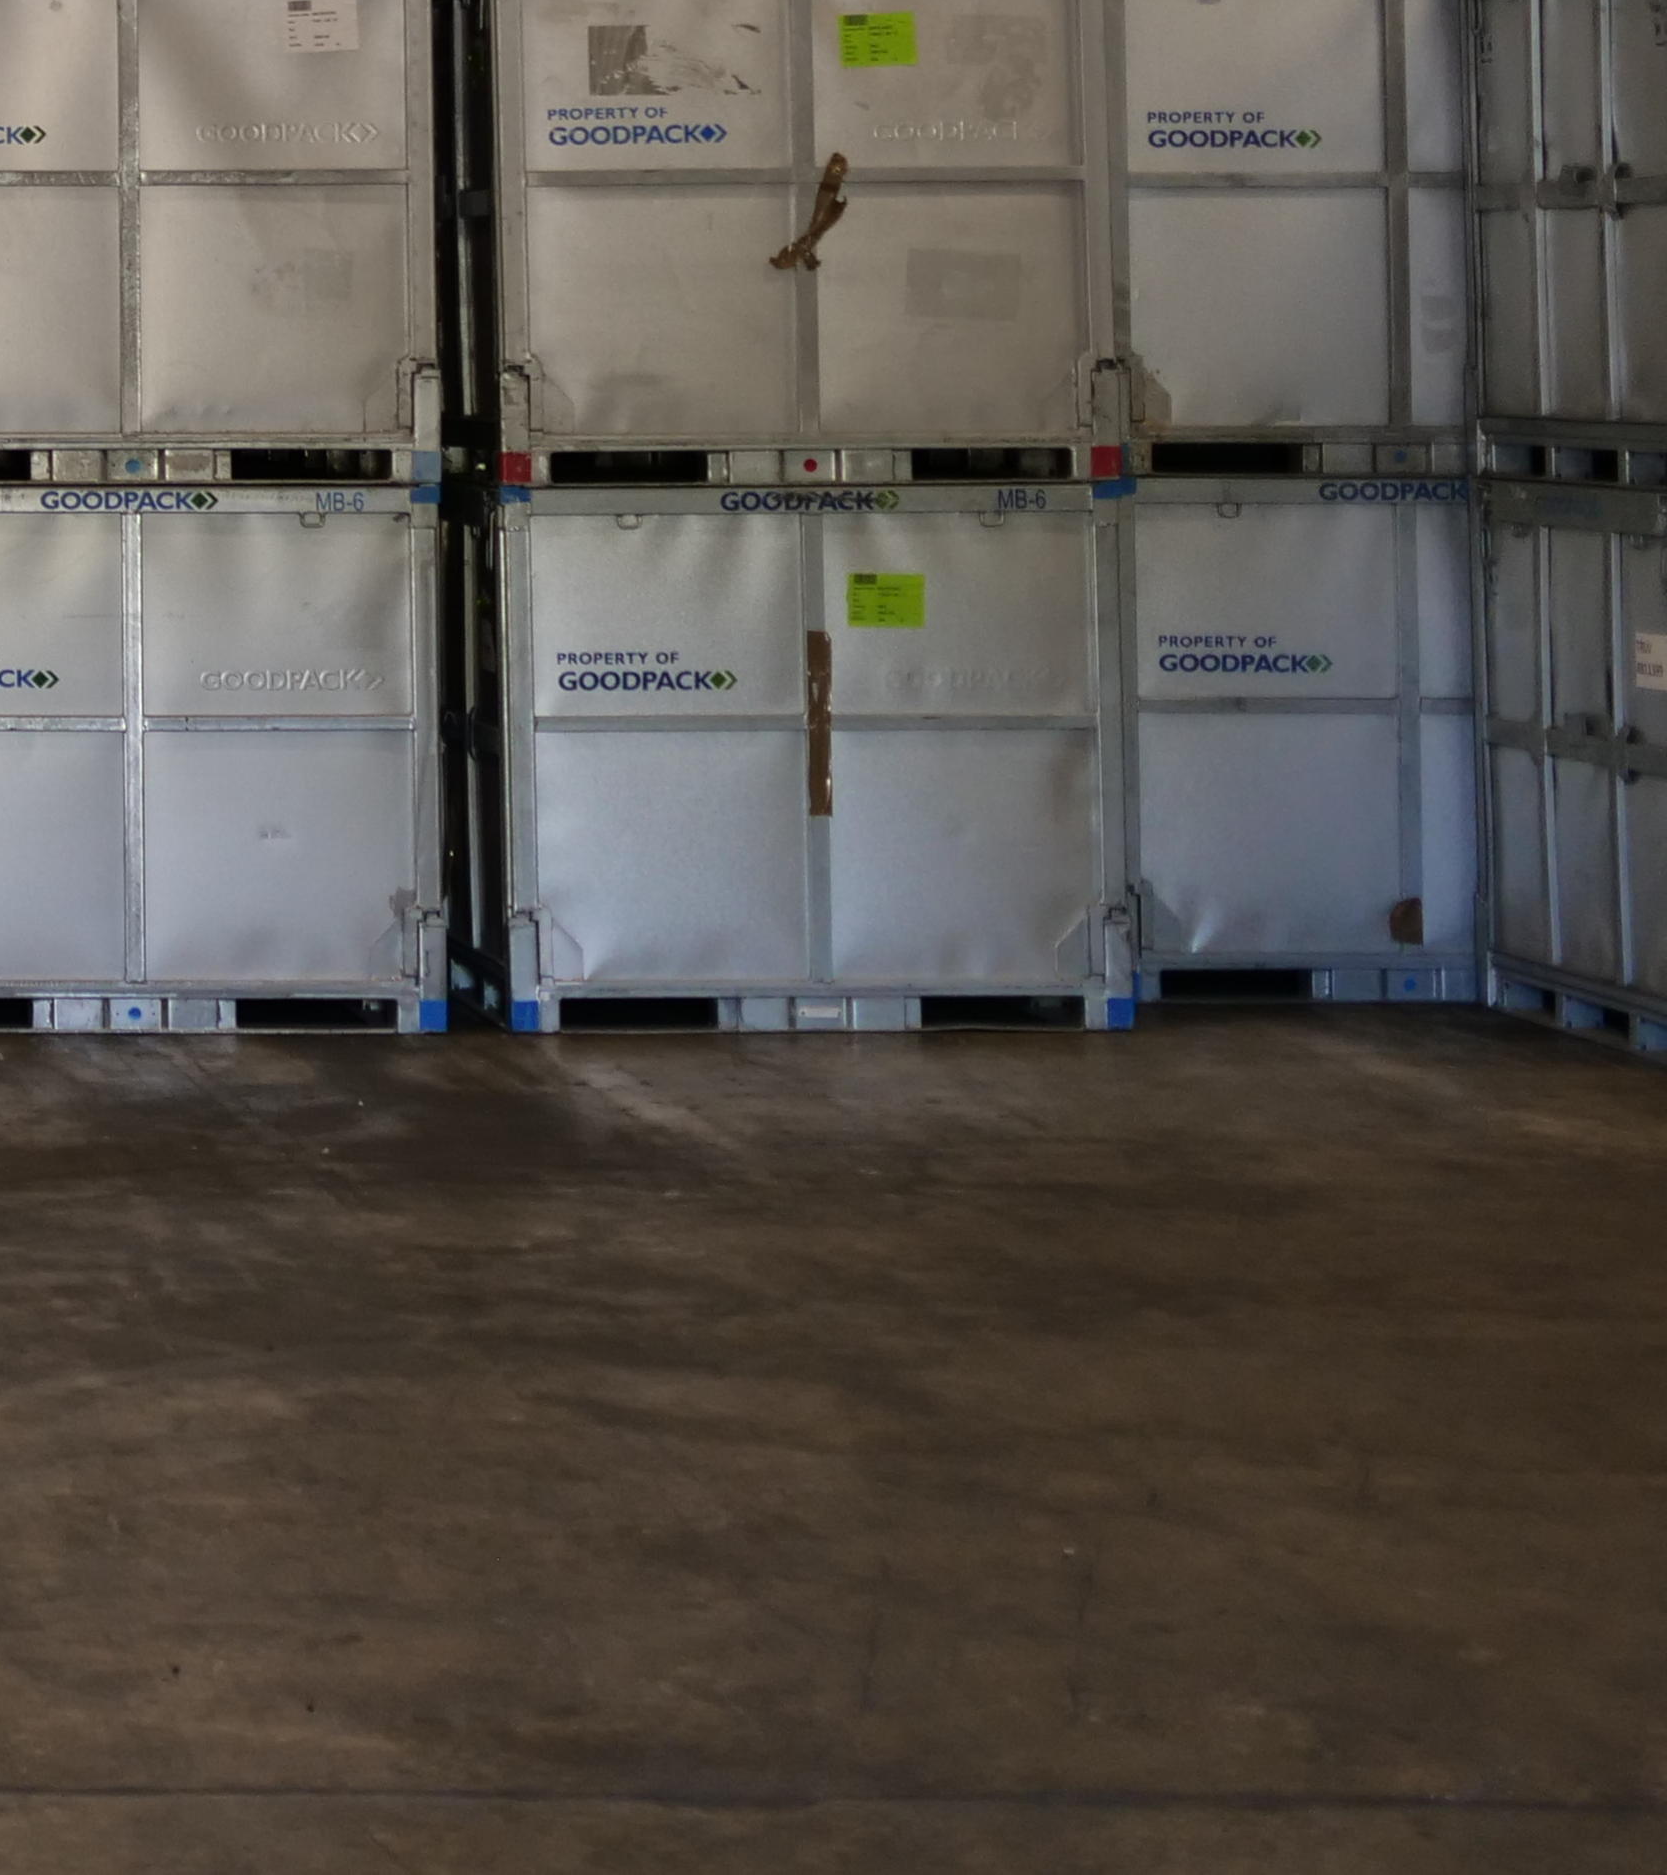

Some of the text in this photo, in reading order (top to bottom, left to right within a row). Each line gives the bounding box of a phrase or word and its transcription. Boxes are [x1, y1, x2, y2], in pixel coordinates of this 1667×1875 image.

[547, 107, 668, 120] PROPERTY OF
[1147, 111, 1265, 124] PROPERTY OF
[549, 124, 702, 145] GOODPACK
[1148, 130, 1297, 148] GOODPACK
[997, 490, 1047, 509] MB-6
[1319, 482, 1468, 501] GOODPACK
[40, 491, 364, 512] GOODPACK MB-6
[1158, 635, 1276, 648] PROPERTY OF
[557, 651, 680, 665] PROPERTY OF
[1159, 654, 1309, 673] GOODPACK
[558, 671, 713, 691] GOODPACK
